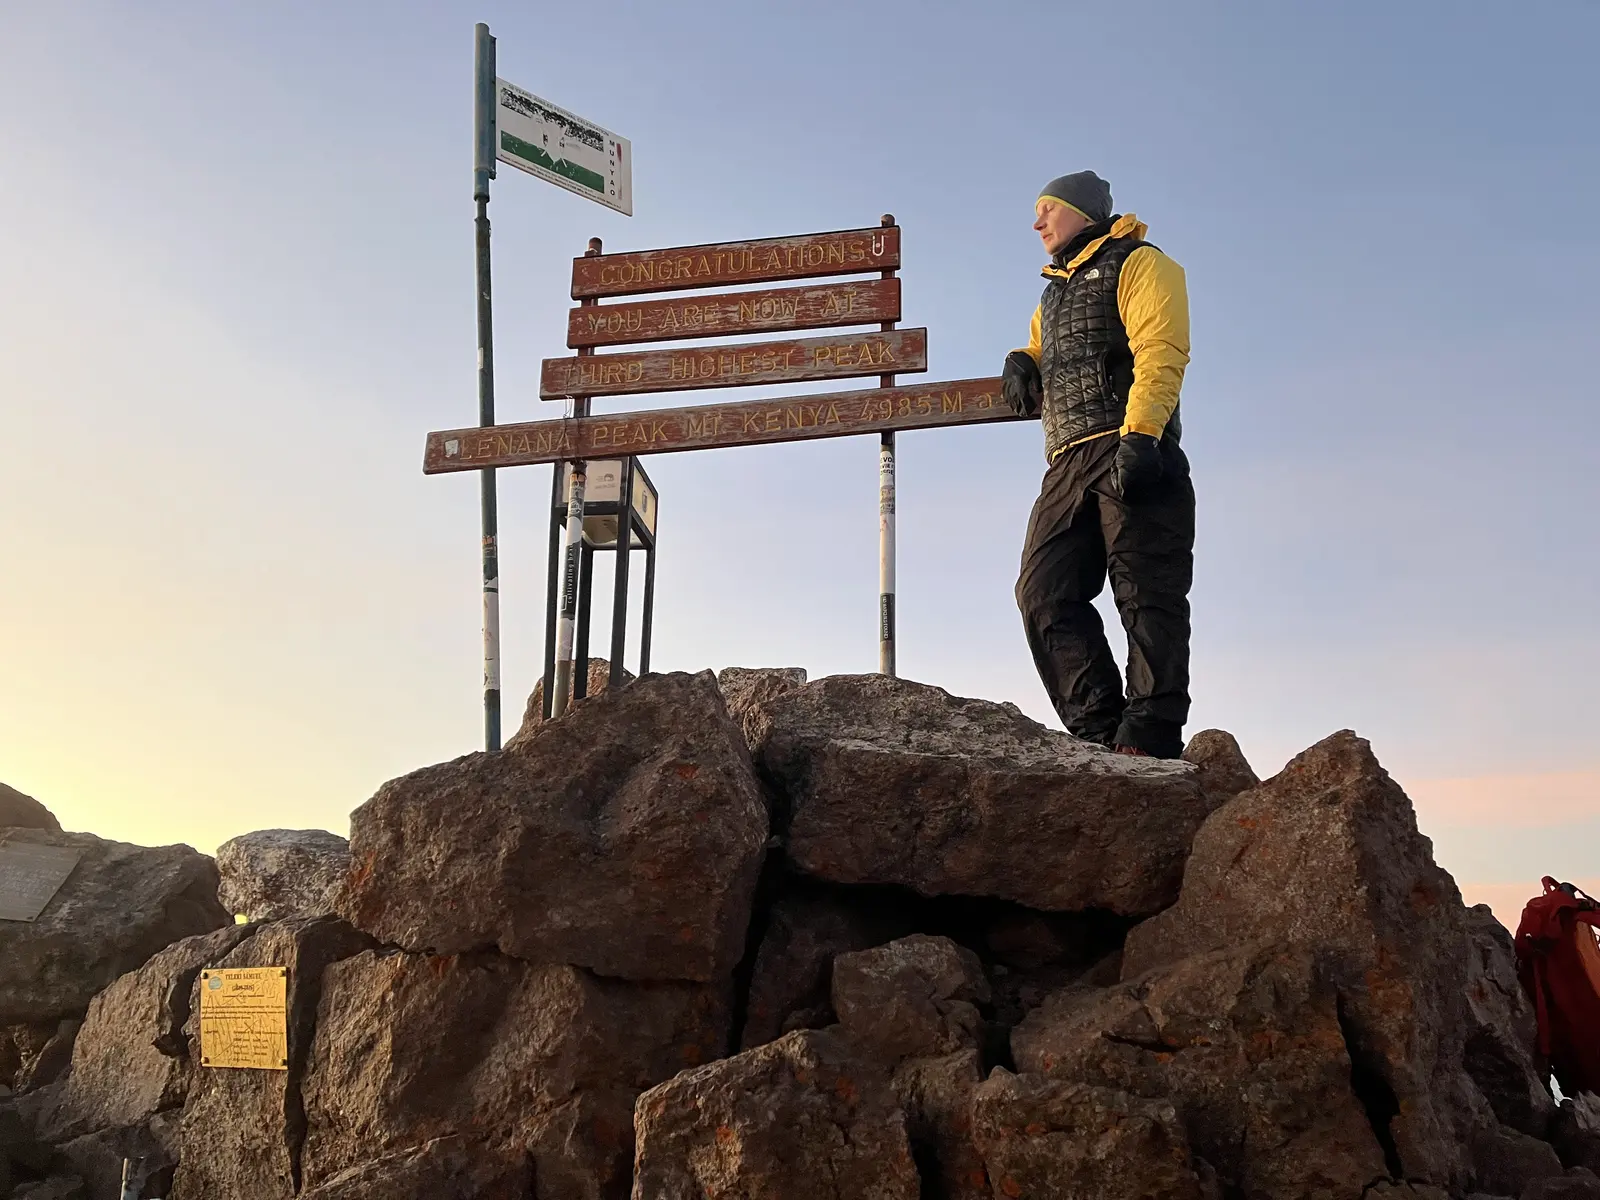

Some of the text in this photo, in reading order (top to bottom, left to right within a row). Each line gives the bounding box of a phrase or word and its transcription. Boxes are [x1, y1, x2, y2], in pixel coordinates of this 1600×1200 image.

[600, 239, 865, 286] CONGRATULATIONS
[588, 290, 857, 335] YOU ARE NOW AT
[562, 342, 896, 386] THIRD HIGHEST PEAK
[459, 431, 572, 460] LENANA
[592, 419, 669, 448] PEAK
[687, 412, 723, 439] MT
[743, 402, 841, 433] KENYA
[860, 393, 933, 421] 4985
[940, 391, 963, 414] M
